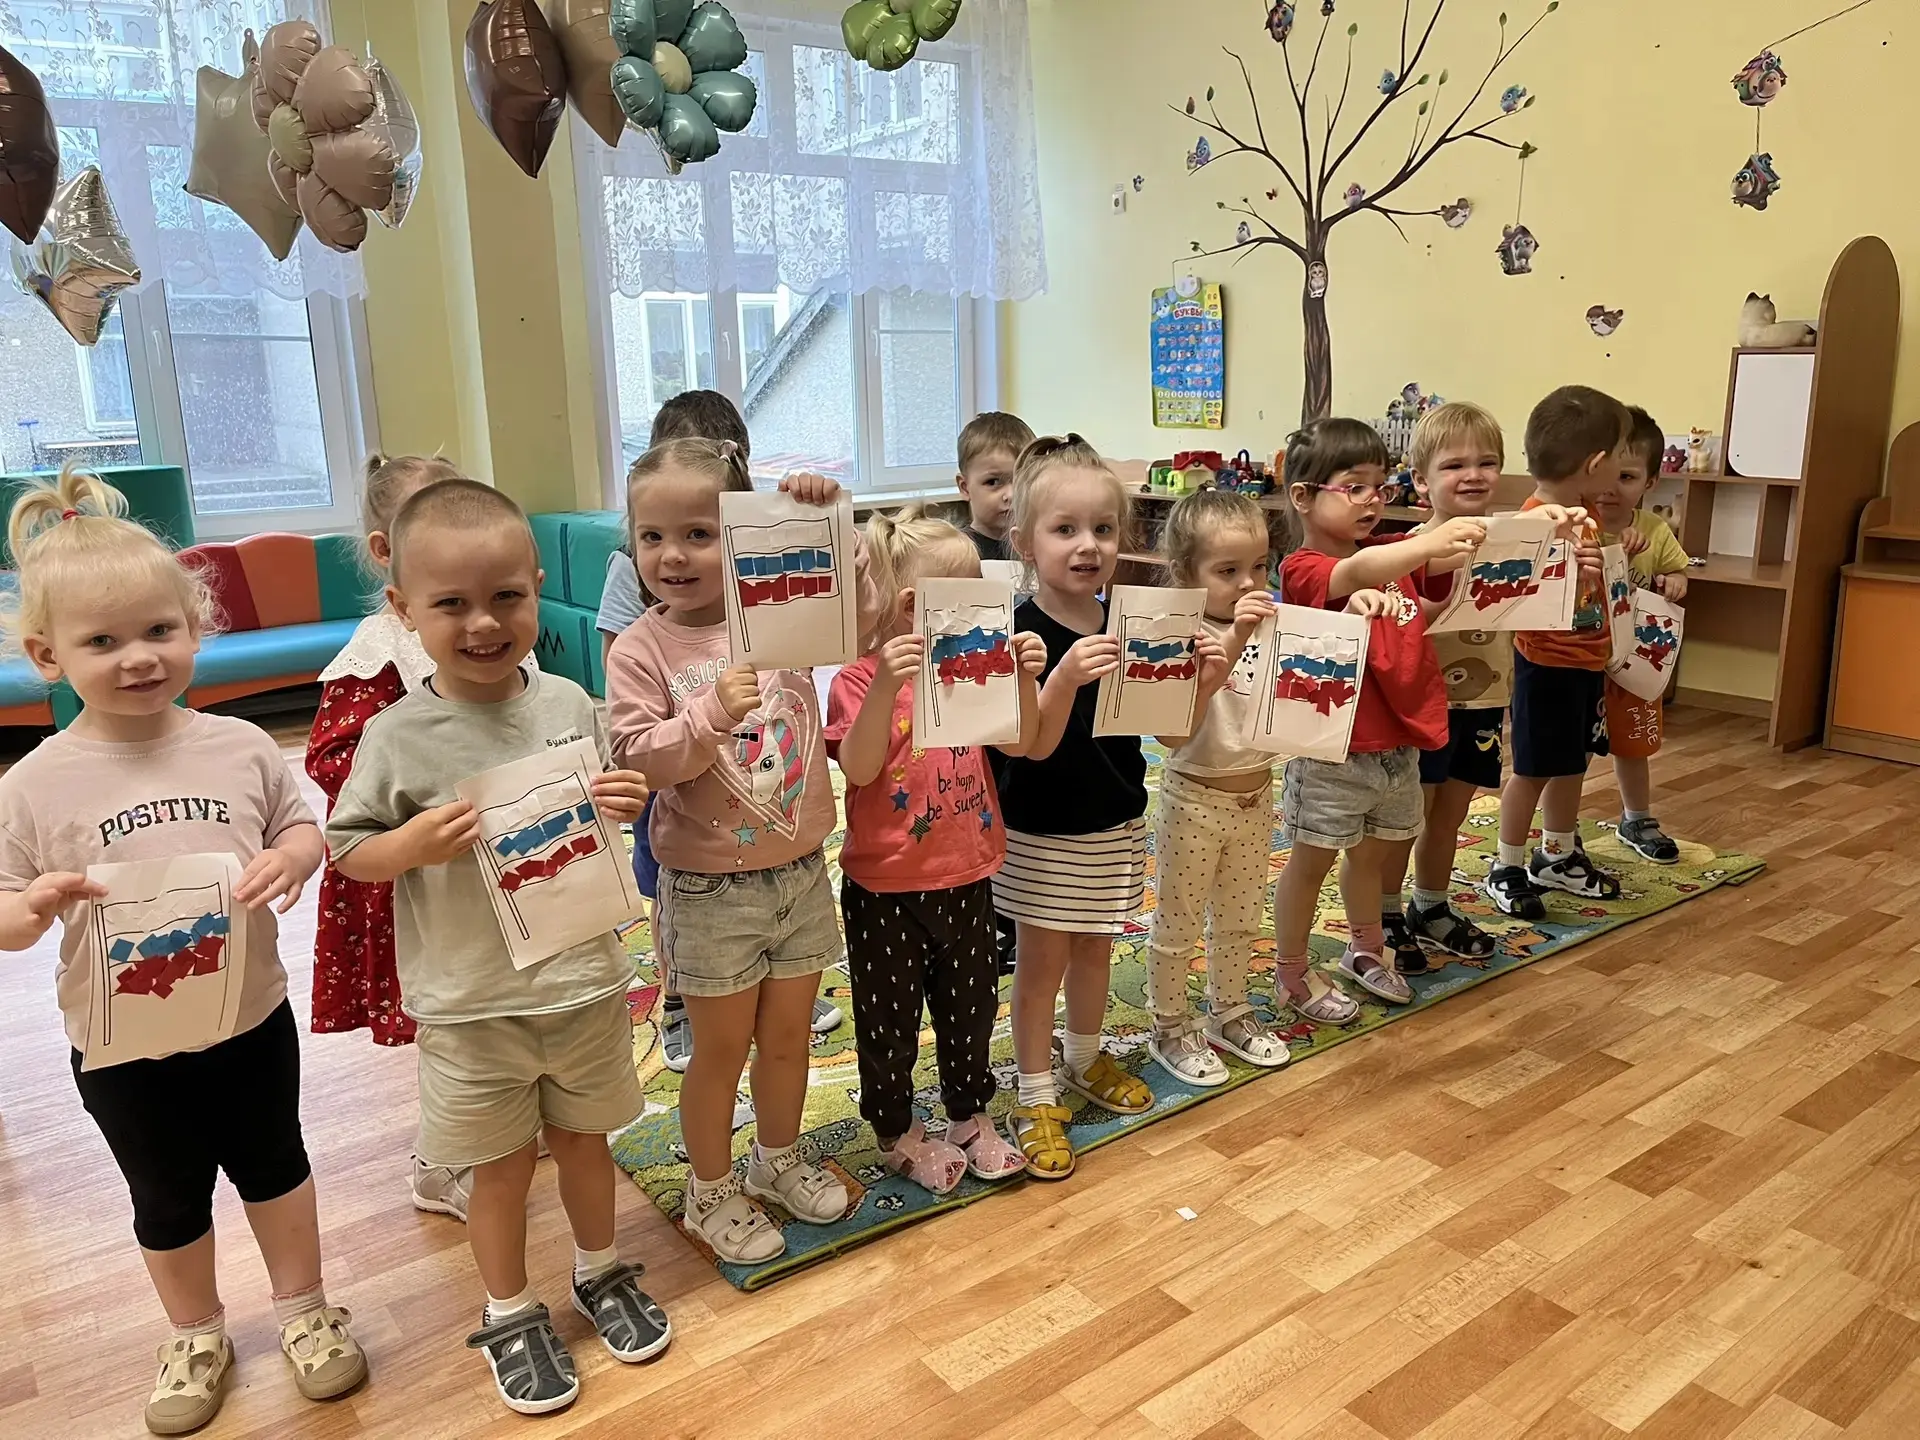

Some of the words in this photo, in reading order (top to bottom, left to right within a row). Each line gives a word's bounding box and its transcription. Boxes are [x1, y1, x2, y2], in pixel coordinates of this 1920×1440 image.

[1174, 308, 1203, 318] БУКВЫ
[1626, 706, 1646, 739] party
[937, 767, 952, 794] be
[926, 795, 943, 823] be
[952, 782, 986, 816] sweet
[98, 797, 231, 848] POSITIVE
